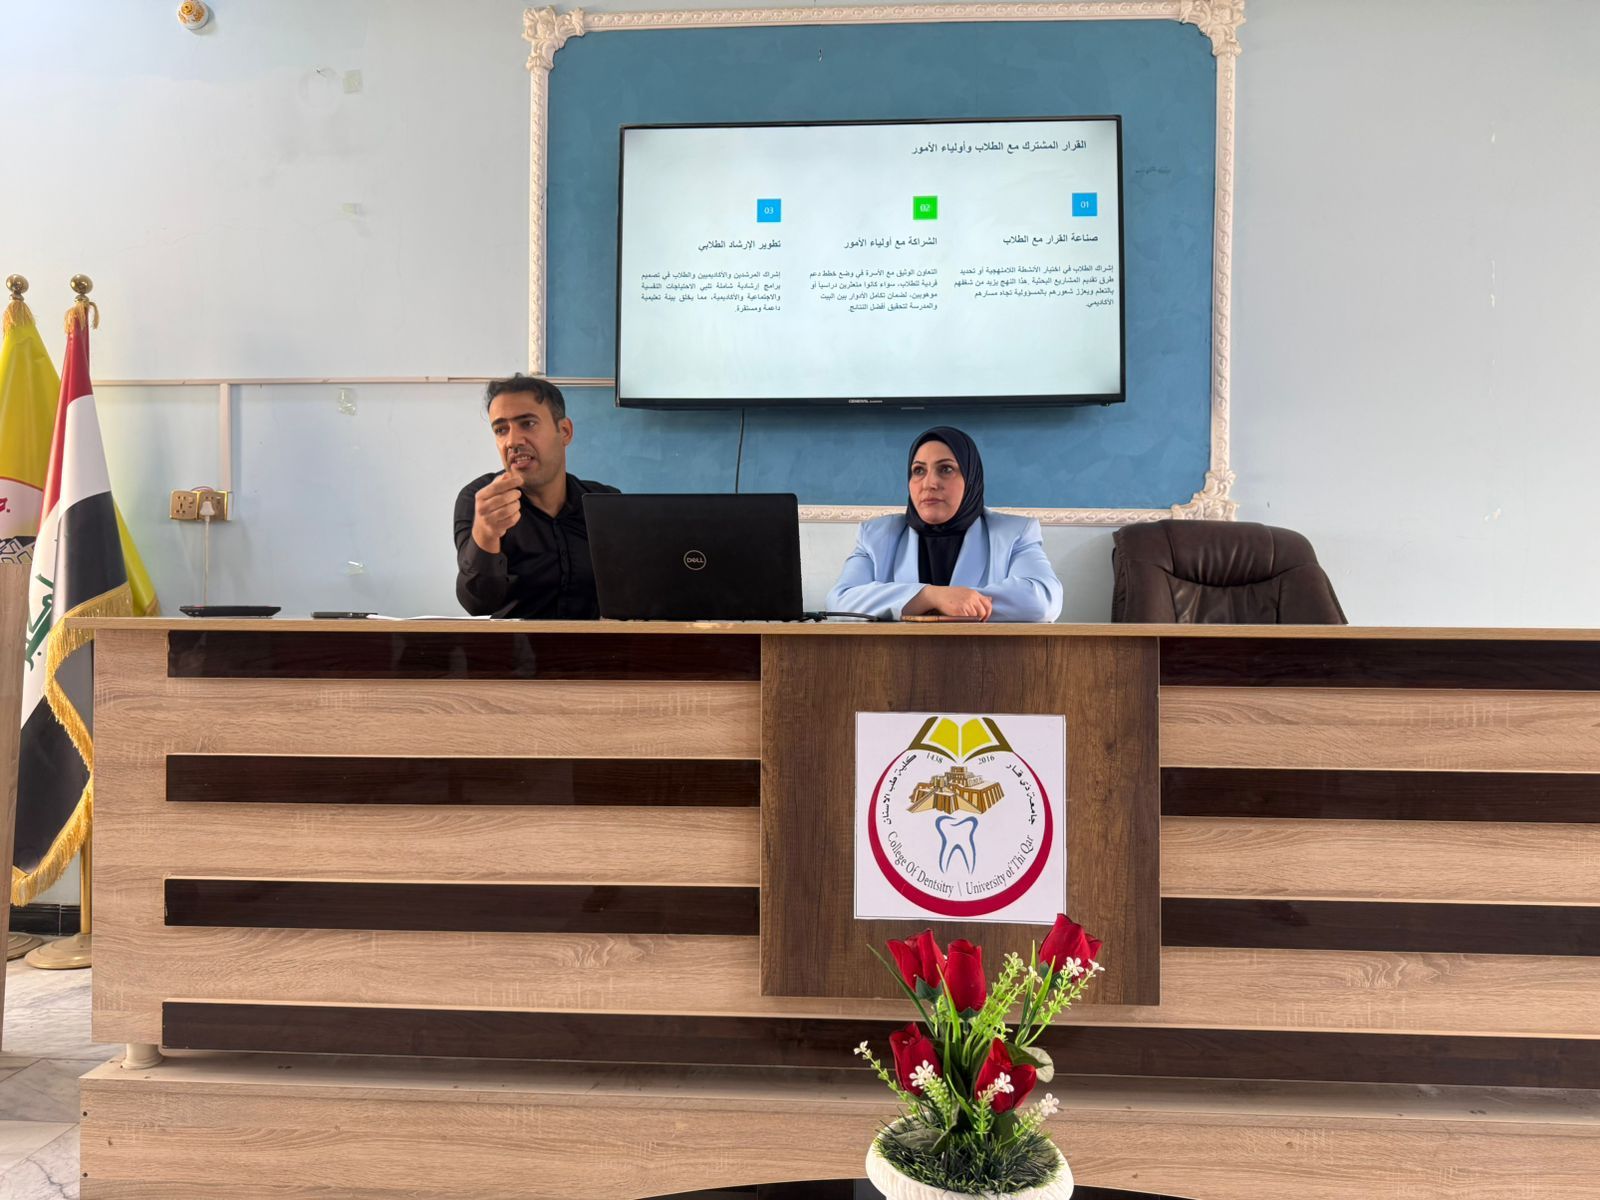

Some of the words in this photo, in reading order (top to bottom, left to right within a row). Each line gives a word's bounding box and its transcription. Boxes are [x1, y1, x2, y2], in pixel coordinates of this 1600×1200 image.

[912, 142, 937, 154] الأمور
[941, 141, 972, 154] وأولياء
[975, 141, 1003, 153] الطلاب
[1007, 144, 1019, 154] مع
[1022, 141, 1058, 152] المشترك
[1062, 140, 1086, 151] القرار
[763, 207, 774, 215] 03
[920, 204, 931, 212] 02
[1080, 201, 1089, 209] 01
[844, 237, 867, 249] الأمور
[870, 236, 892, 248] أولياء
[908, 236, 937, 247] الشراكة
[1003, 235, 1029, 245] الطلاب
[1032, 237, 1043, 247] مع
[1046, 234, 1068, 245] القرار
[1071, 233, 1098, 242] صناعة
[698, 240, 726, 252] الطلابي
[729, 240, 755, 251] الإرشاد
[758, 240, 781, 250] تطوير
[895, 240, 905, 249] مع
[894, 754, 917, 776] كلية
[978, 755, 995, 765] 2016
[1005, 764, 1024, 778] قار
[889, 777, 898, 792] طب
[1026, 792, 1037, 825] جامعة
[887, 831, 907, 866] College
[1020, 834, 1034, 854] Qar
[1010, 851, 1026, 870] Thi
[905, 861, 920, 877] Of
[1006, 862, 1015, 878] of
[965, 873, 1007, 895] University
